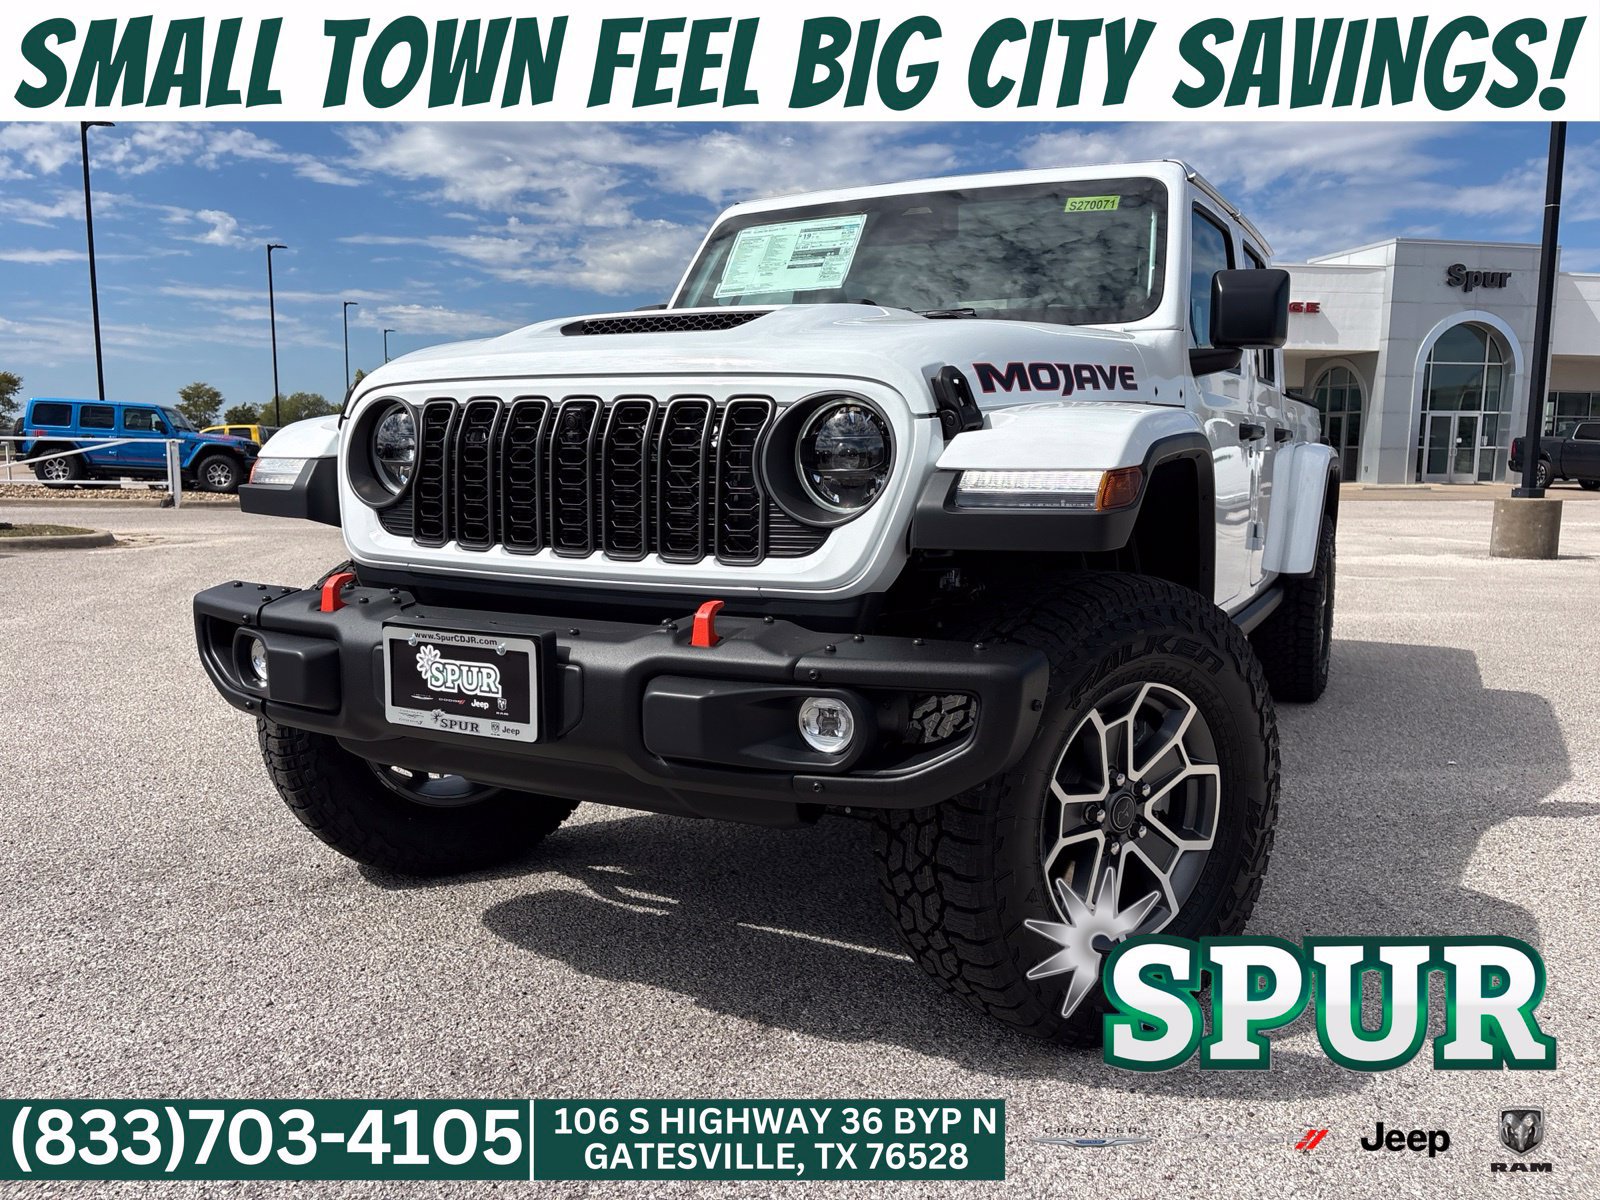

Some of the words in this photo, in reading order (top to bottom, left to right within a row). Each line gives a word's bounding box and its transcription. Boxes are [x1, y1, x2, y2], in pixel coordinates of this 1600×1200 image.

[1068, 198, 1117, 212] S270071
[1446, 263, 1512, 292] Spur
[1288, 301, 1321, 313] GE
[972, 362, 1138, 396] MOJAVE
[415, 632, 497, 646] www.SpurCDJR.com
[429, 661, 501, 695] SPUR
[471, 698, 489, 710] Jeep
[440, 718, 480, 733] SPUR
[502, 725, 520, 735] Jeep
